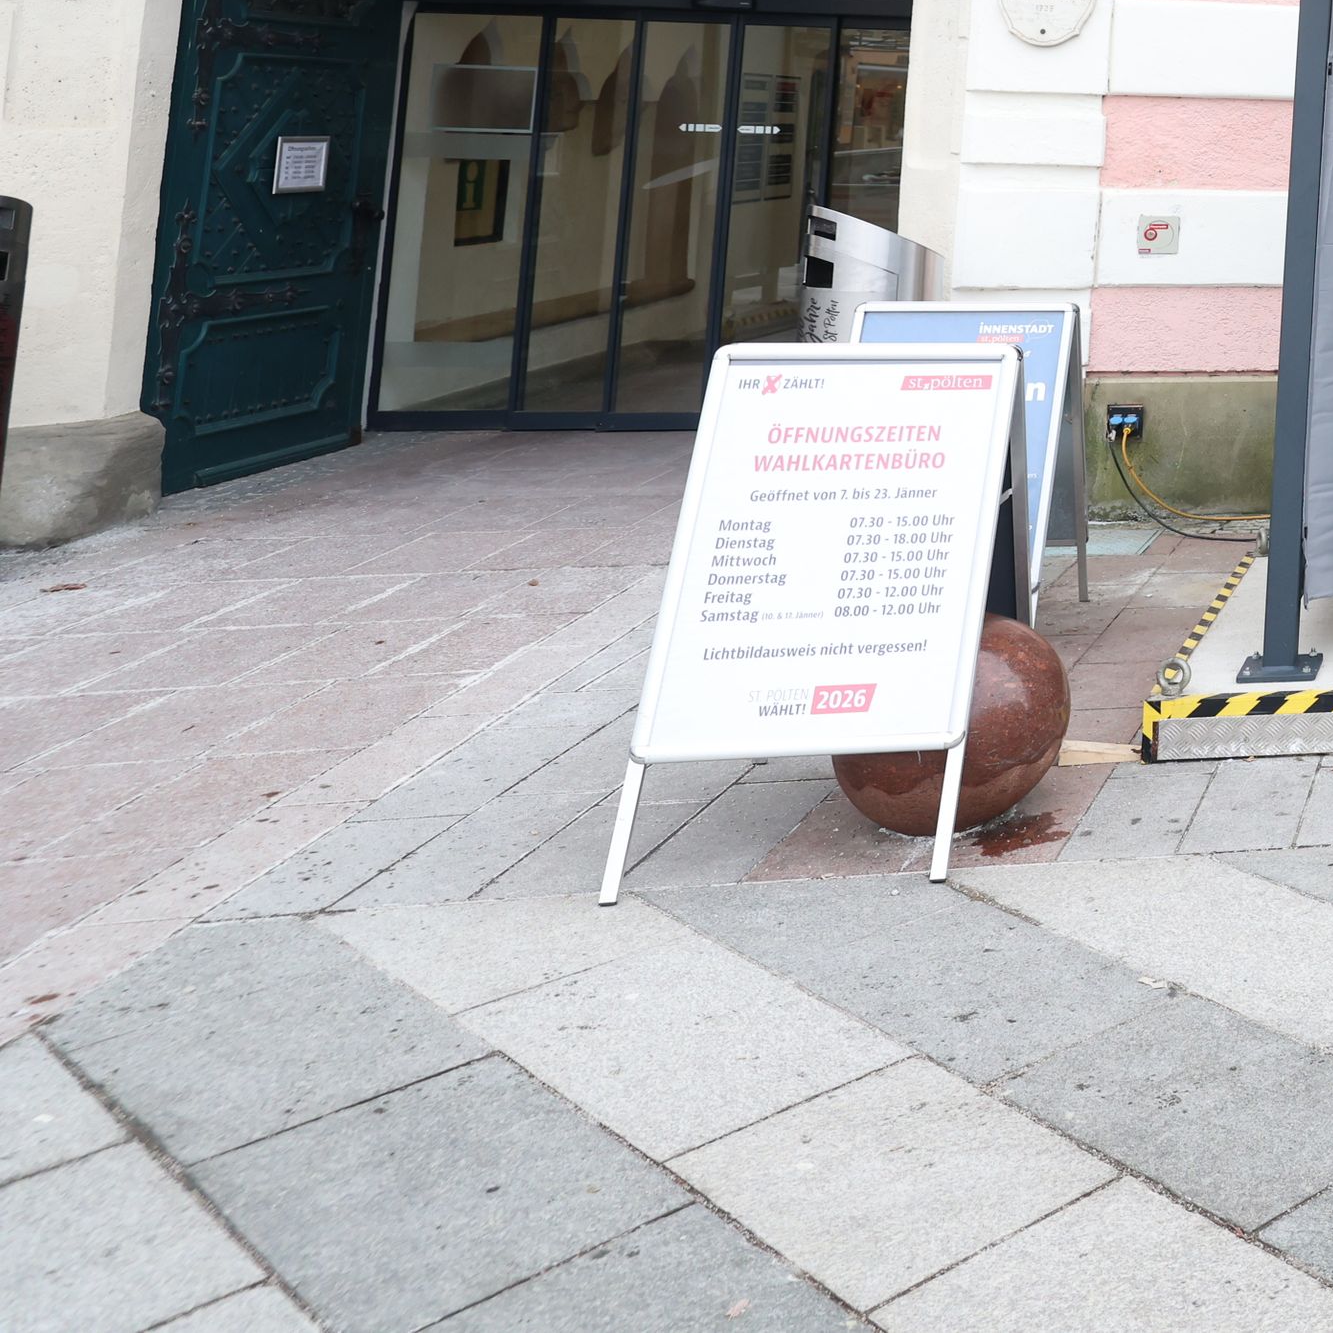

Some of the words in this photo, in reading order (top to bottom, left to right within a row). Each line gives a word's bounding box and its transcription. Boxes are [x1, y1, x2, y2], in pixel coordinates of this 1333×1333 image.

[738, 378, 760, 389] IHR
[783, 376, 825, 389] ZÄHLT!
[767, 424, 942, 444] ÖFFNUNGSZEITEN
[754, 449, 946, 472] WAHLKARTENBÜRO
[750, 489, 810, 502] Geöffnet
[813, 491, 837, 501] von
[840, 489, 848, 500] 7.
[852, 487, 870, 500] bis
[874, 488, 891, 499] 23.
[894, 487, 938, 499] Jänner
[718, 519, 772, 533] Montag
[849, 516, 884, 528] 07.30
[896, 515, 929, 527] 15.00
[932, 514, 956, 526] Uhr
[715, 537, 776, 551] Dienstag
[846, 534, 881, 546] 07.30
[893, 532, 927, 544] 18.00
[930, 531, 953, 544] Uhr
[711, 554, 777, 567] Mittwoch
[843, 551, 878, 564] 07.30
[890, 550, 923, 562] 15.00
[927, 548, 950, 561] Uhr
[707, 573, 788, 586] Donnerstag
[840, 569, 875, 581] 07.30
[887, 567, 920, 580] 15.00
[924, 566, 947, 578] Uhr
[703, 591, 752, 605] Freitag
[837, 587, 872, 599] 07.30
[884, 585, 917, 597] 12.00
[921, 584, 944, 596] Uhr
[700, 609, 759, 623] Samstag
[834, 604, 869, 617] 08.00
[881, 603, 914, 615] 12.00
[918, 601, 941, 614] Uhr
[703, 643, 816, 660] Lichtbildausweis
[820, 642, 854, 656] nicht
[857, 639, 928, 656] vergessen!
[748, 690, 763, 703] ST.
[816, 689, 867, 710] 2026
[758, 702, 807, 717] WÄHLT!
